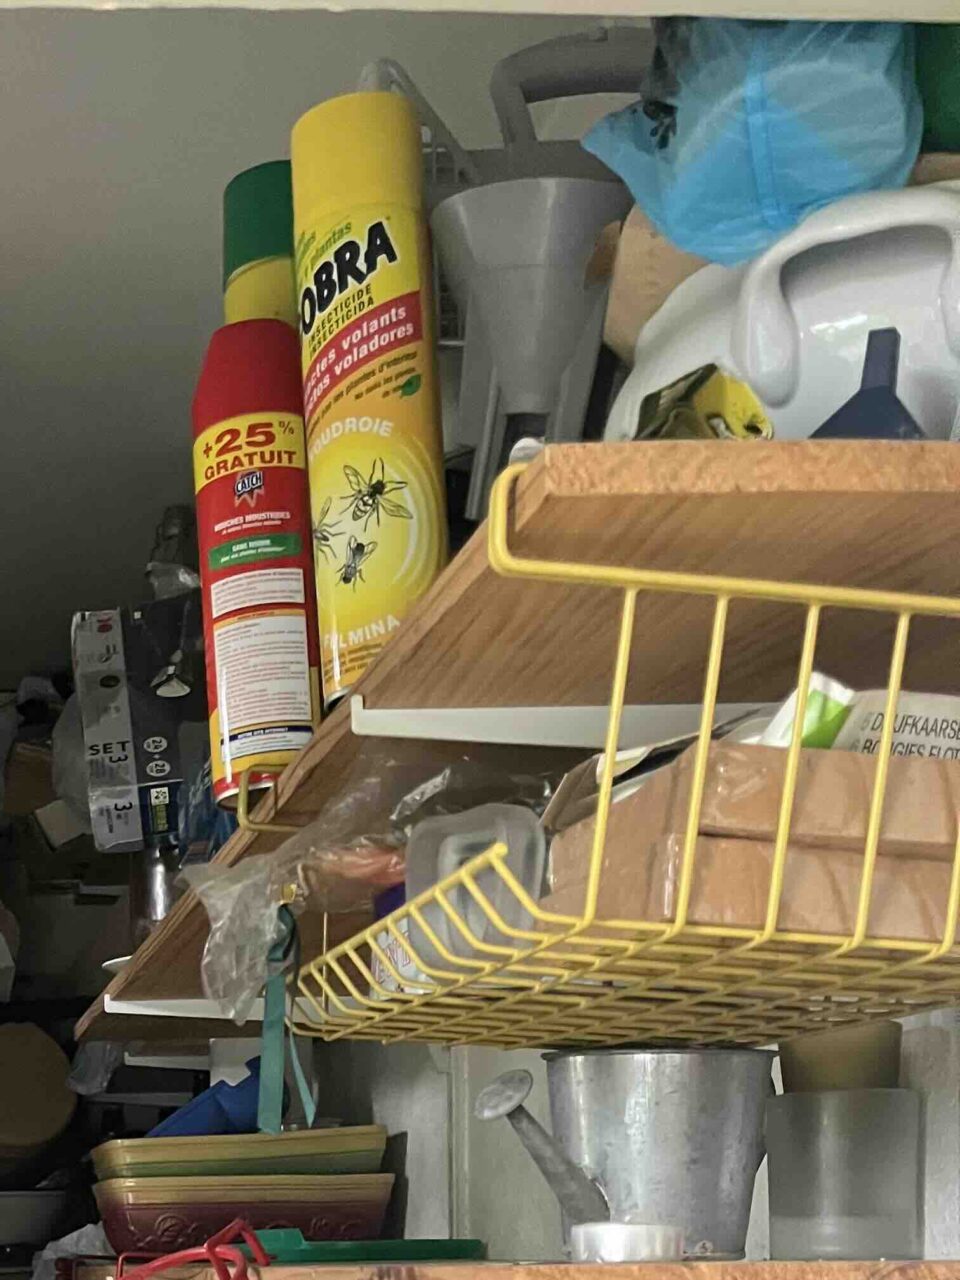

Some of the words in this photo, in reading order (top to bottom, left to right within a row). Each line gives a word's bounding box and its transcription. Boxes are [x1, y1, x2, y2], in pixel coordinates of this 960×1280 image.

[342, 306, 407, 350] volants
[334, 322, 415, 376] voladores
[204, 450, 297, 481] GRATUIT
[236, 473, 262, 494] CATCH
[324, 613, 400, 649] FLMINA
[88, 740, 131, 756] SET
